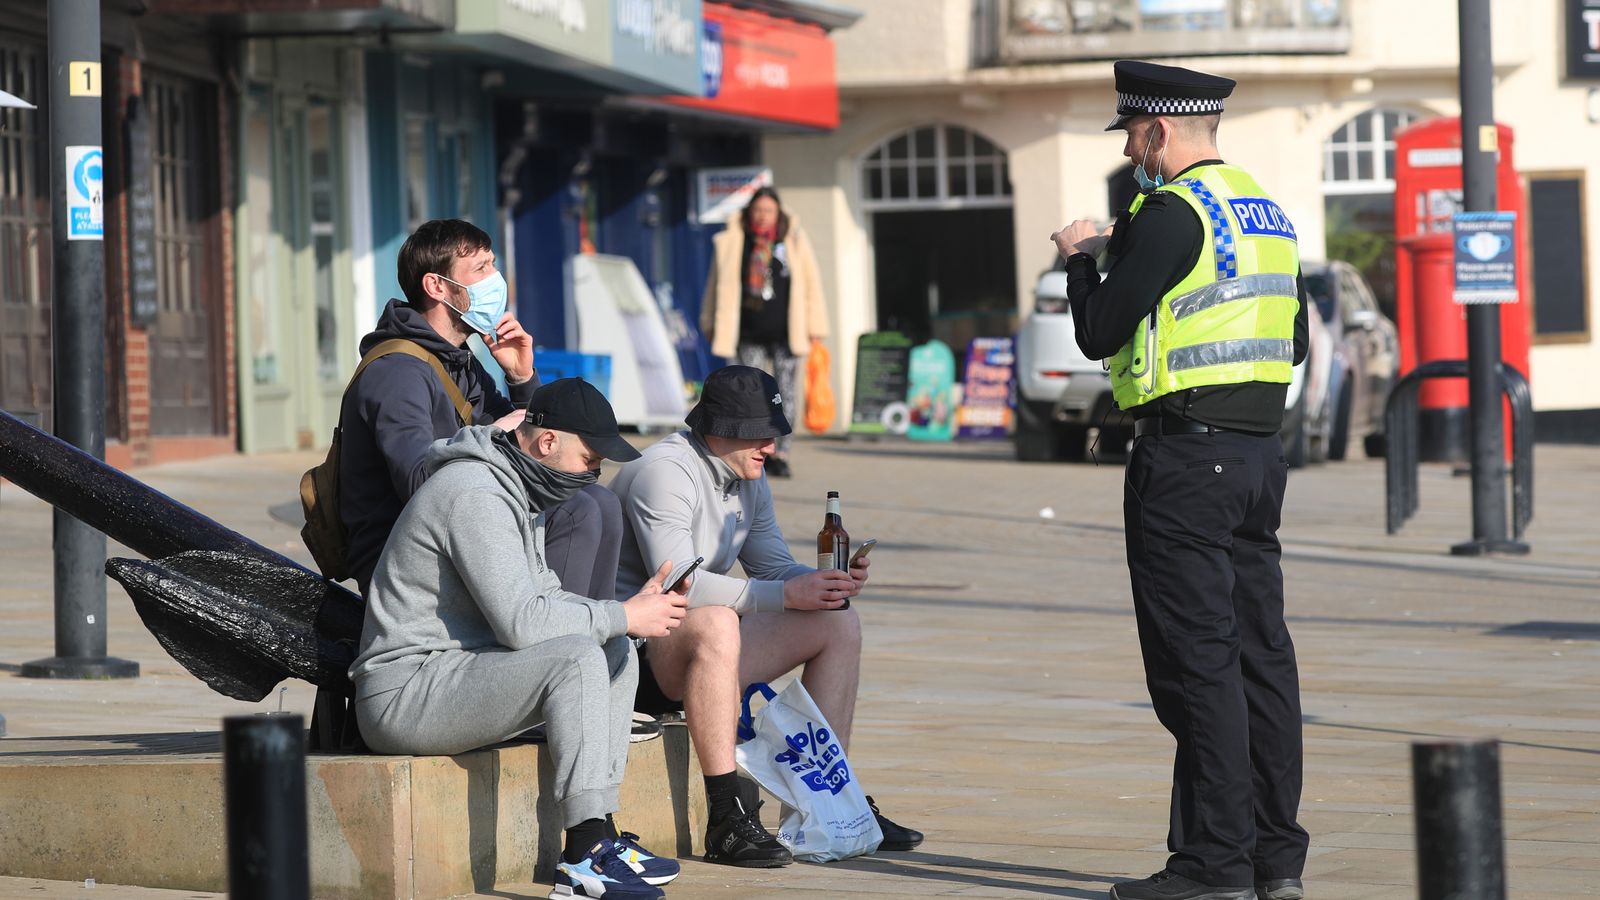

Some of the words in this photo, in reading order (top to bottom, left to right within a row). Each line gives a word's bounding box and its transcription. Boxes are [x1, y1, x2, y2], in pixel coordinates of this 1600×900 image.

[82, 67, 91, 91] 1
[1457, 221, 1485, 230] Protect
[1488, 221, 1513, 230] others
[1457, 262, 1485, 271] Please
[1457, 272, 1476, 281] face
[1479, 273, 1514, 283] covering
[826, 768, 847, 789] top
